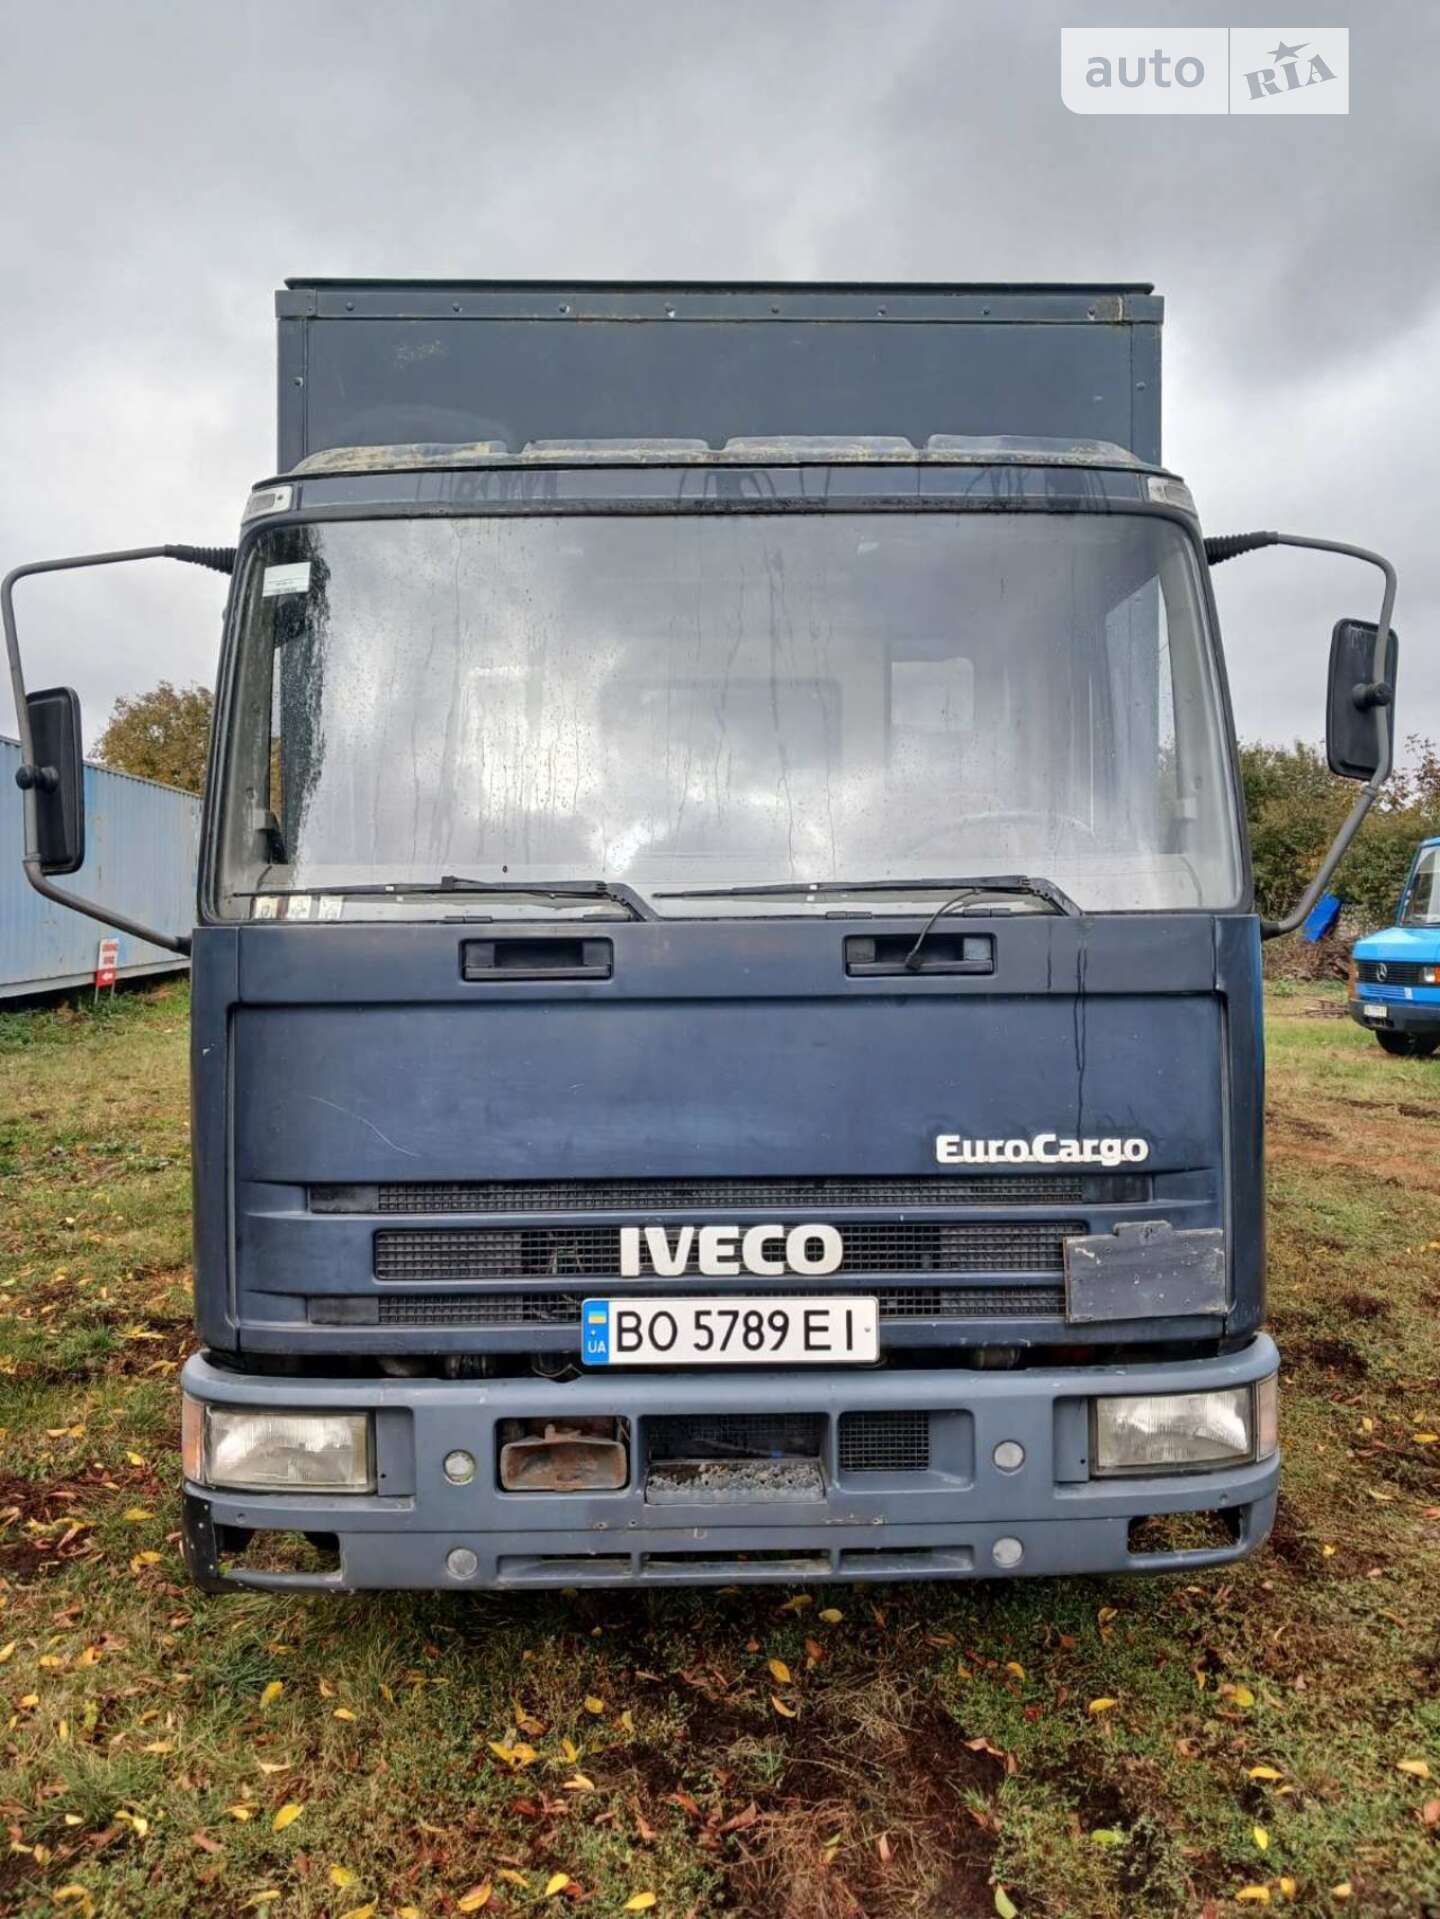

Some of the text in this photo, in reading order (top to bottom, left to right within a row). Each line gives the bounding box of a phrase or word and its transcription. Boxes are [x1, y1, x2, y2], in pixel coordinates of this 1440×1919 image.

[935, 1133, 1149, 1166] EuroCargo
[620, 1224, 843, 1277] IVECO
[588, 1340, 606, 1353] UA
[616, 1309, 853, 1353] BO 5789 EI
